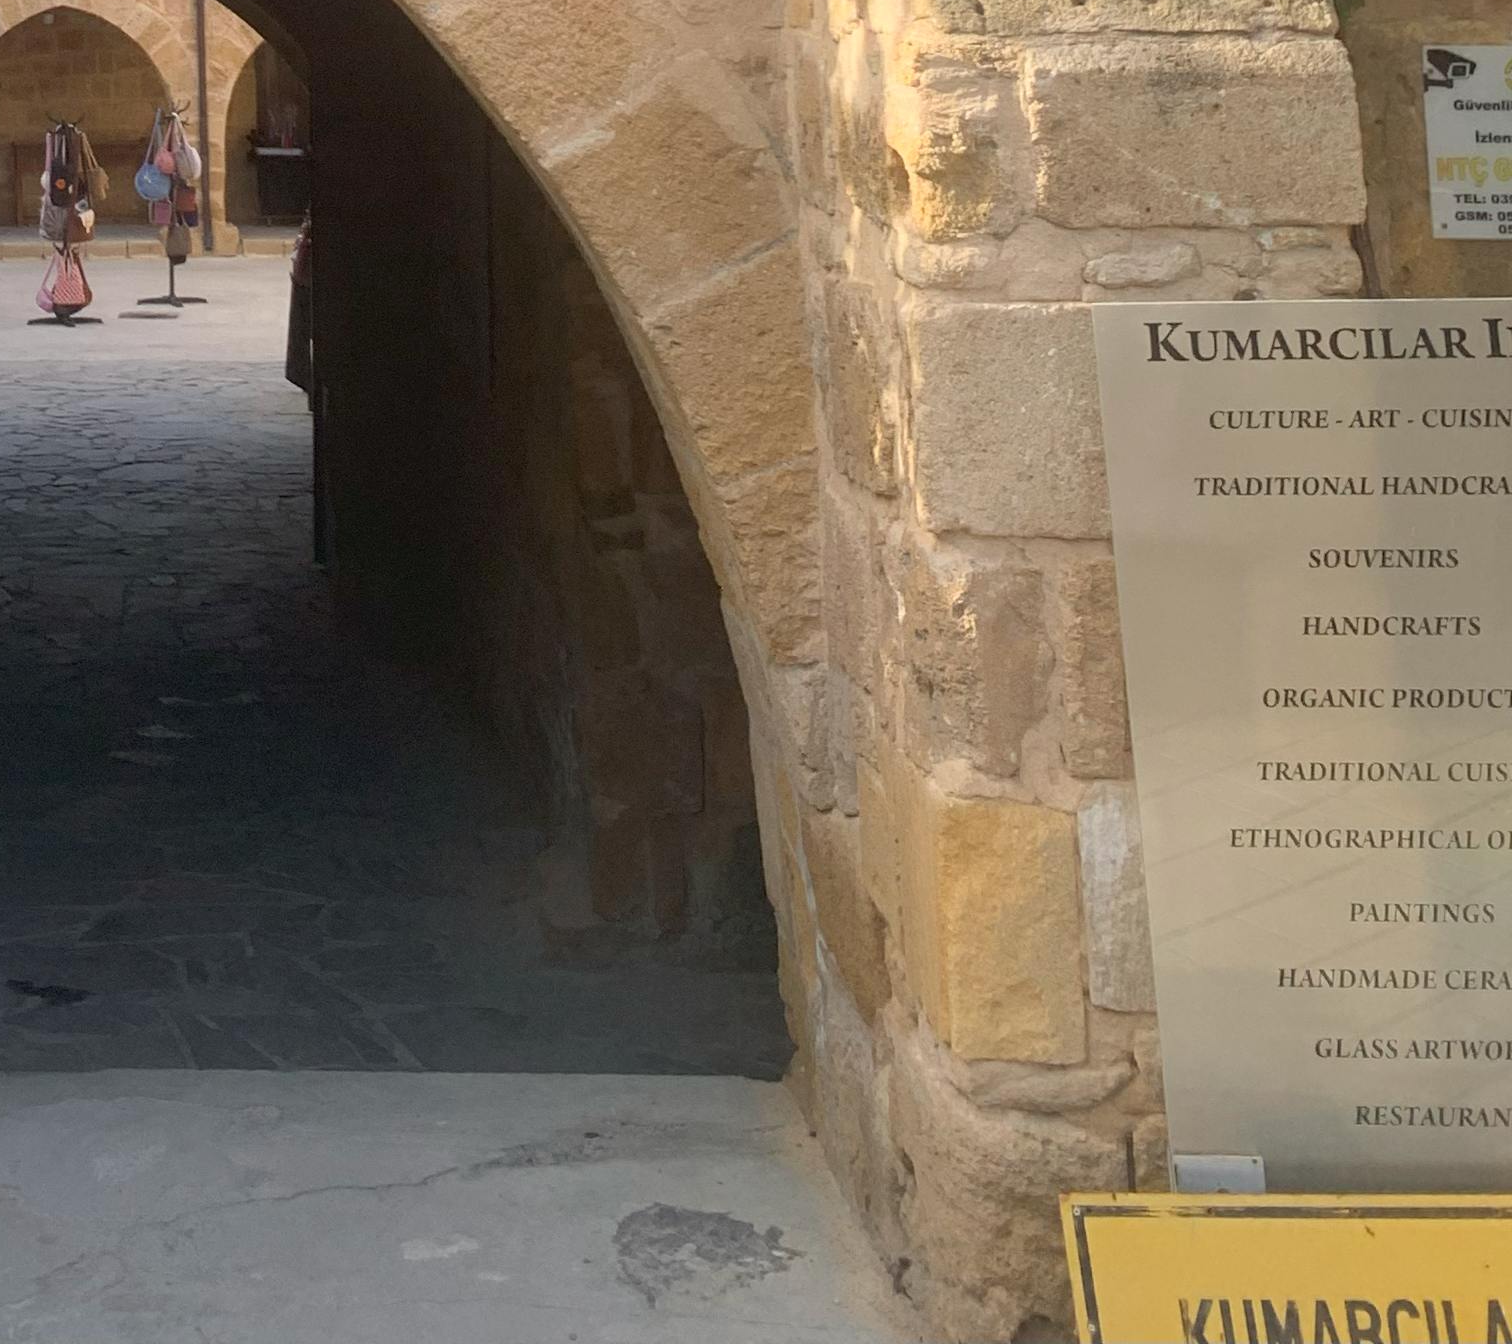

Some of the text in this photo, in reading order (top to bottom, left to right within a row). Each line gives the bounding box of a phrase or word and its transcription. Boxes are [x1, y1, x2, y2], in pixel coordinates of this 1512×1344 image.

[1453, 98, 1512, 112] Güvenli
[1453, 193, 1487, 204] TEL:
[1454, 211, 1494, 222] GSM:
[1143, 318, 1512, 362] KUMARCILAR I
[1209, 409, 1329, 430] CULTURE
[1348, 409, 1401, 429] ART
[1421, 408, 1512, 429] CUISIN
[1194, 475, 1512, 496] TRADITIONAL HANDCRA
[1308, 548, 1459, 569] SOUVENIRS
[1303, 616, 1481, 637] HANDCRAFTS
[1262, 688, 1386, 709] ORGANIC
[1256, 761, 1512, 783] TRADITIONAL CUIS
[1230, 828, 1480, 850] ETHNOGRAPHICAL
[1350, 903, 1496, 924] PAINTINGS
[1278, 968, 1512, 991] HANDMADE CERA
[1314, 1038, 1398, 1060] GLASS
[1355, 1105, 1512, 1128] RESTAURAN
